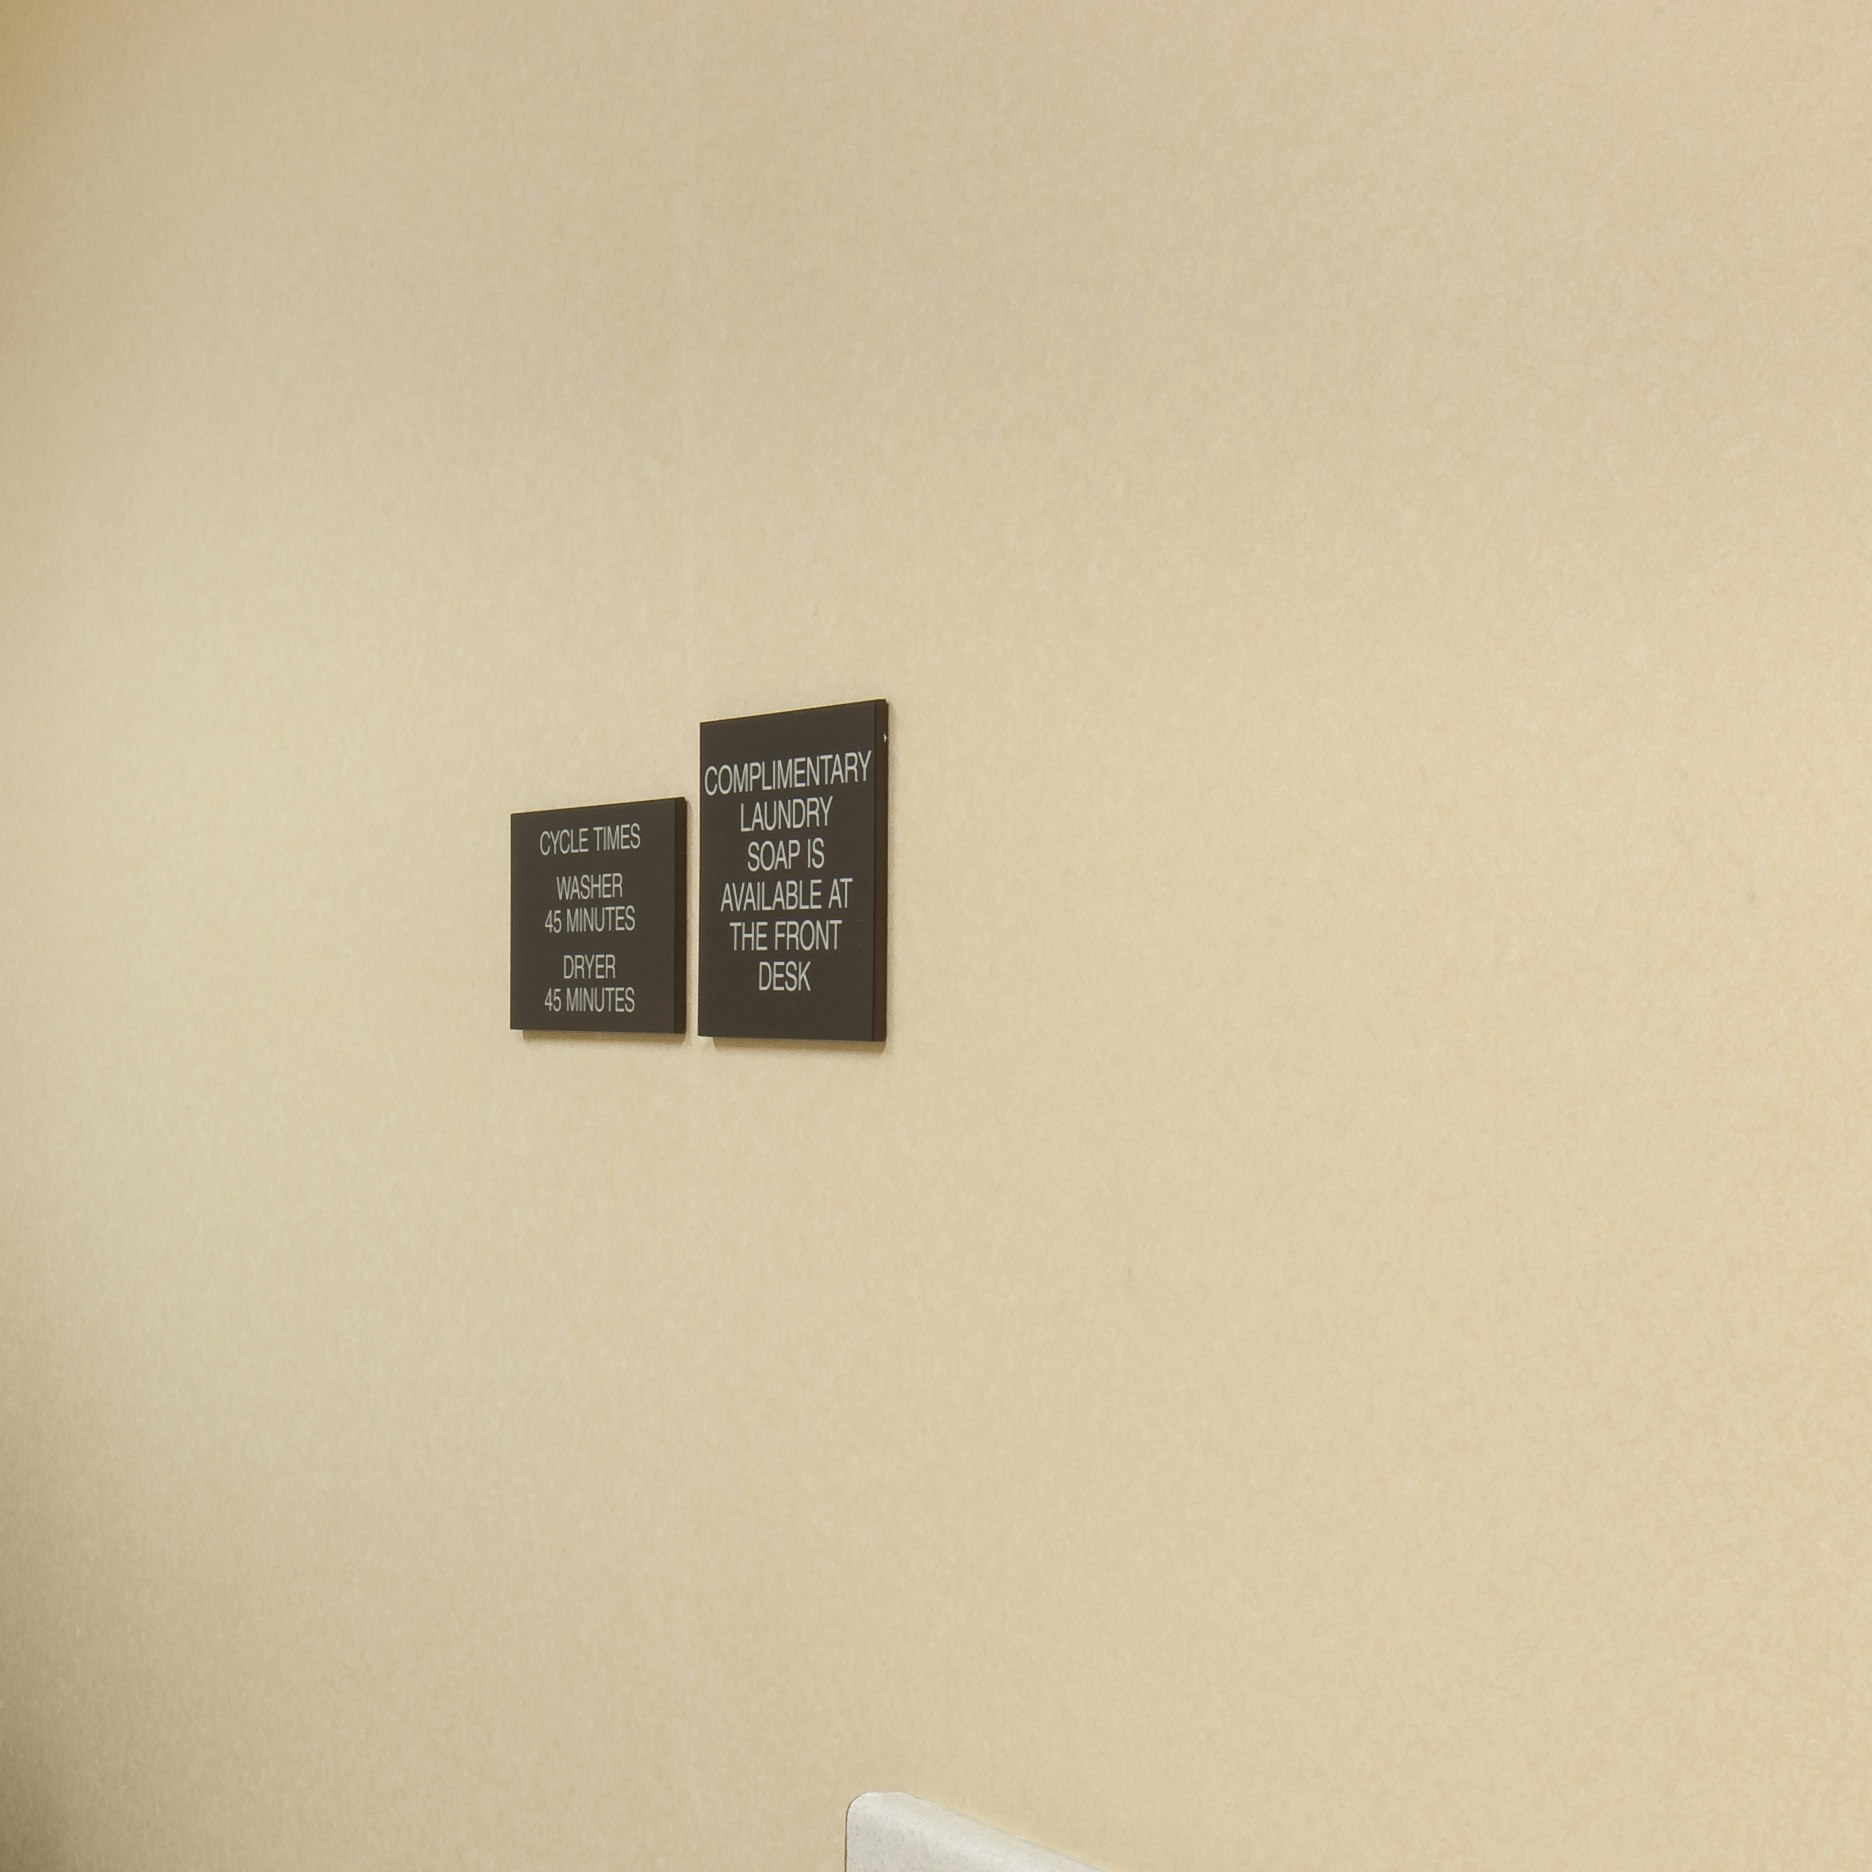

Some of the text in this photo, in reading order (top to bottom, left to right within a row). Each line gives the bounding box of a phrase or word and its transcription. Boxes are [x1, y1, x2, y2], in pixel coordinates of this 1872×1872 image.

[704, 750, 872, 796] COMPLIMENTARY
[740, 796, 833, 832] LAUNDRY
[539, 822, 641, 856] CYCLE TIMES
[747, 837, 825, 872] SOAP IS
[556, 872, 623, 901] WASHER
[720, 877, 854, 912] AVAILABLE AT
[544, 904, 636, 934] 45 MINUTES
[729, 919, 843, 951] THE FRONT
[563, 953, 616, 980] DRYER
[758, 960, 811, 992] DESK
[544, 986, 636, 1013] 45 MINUTES
